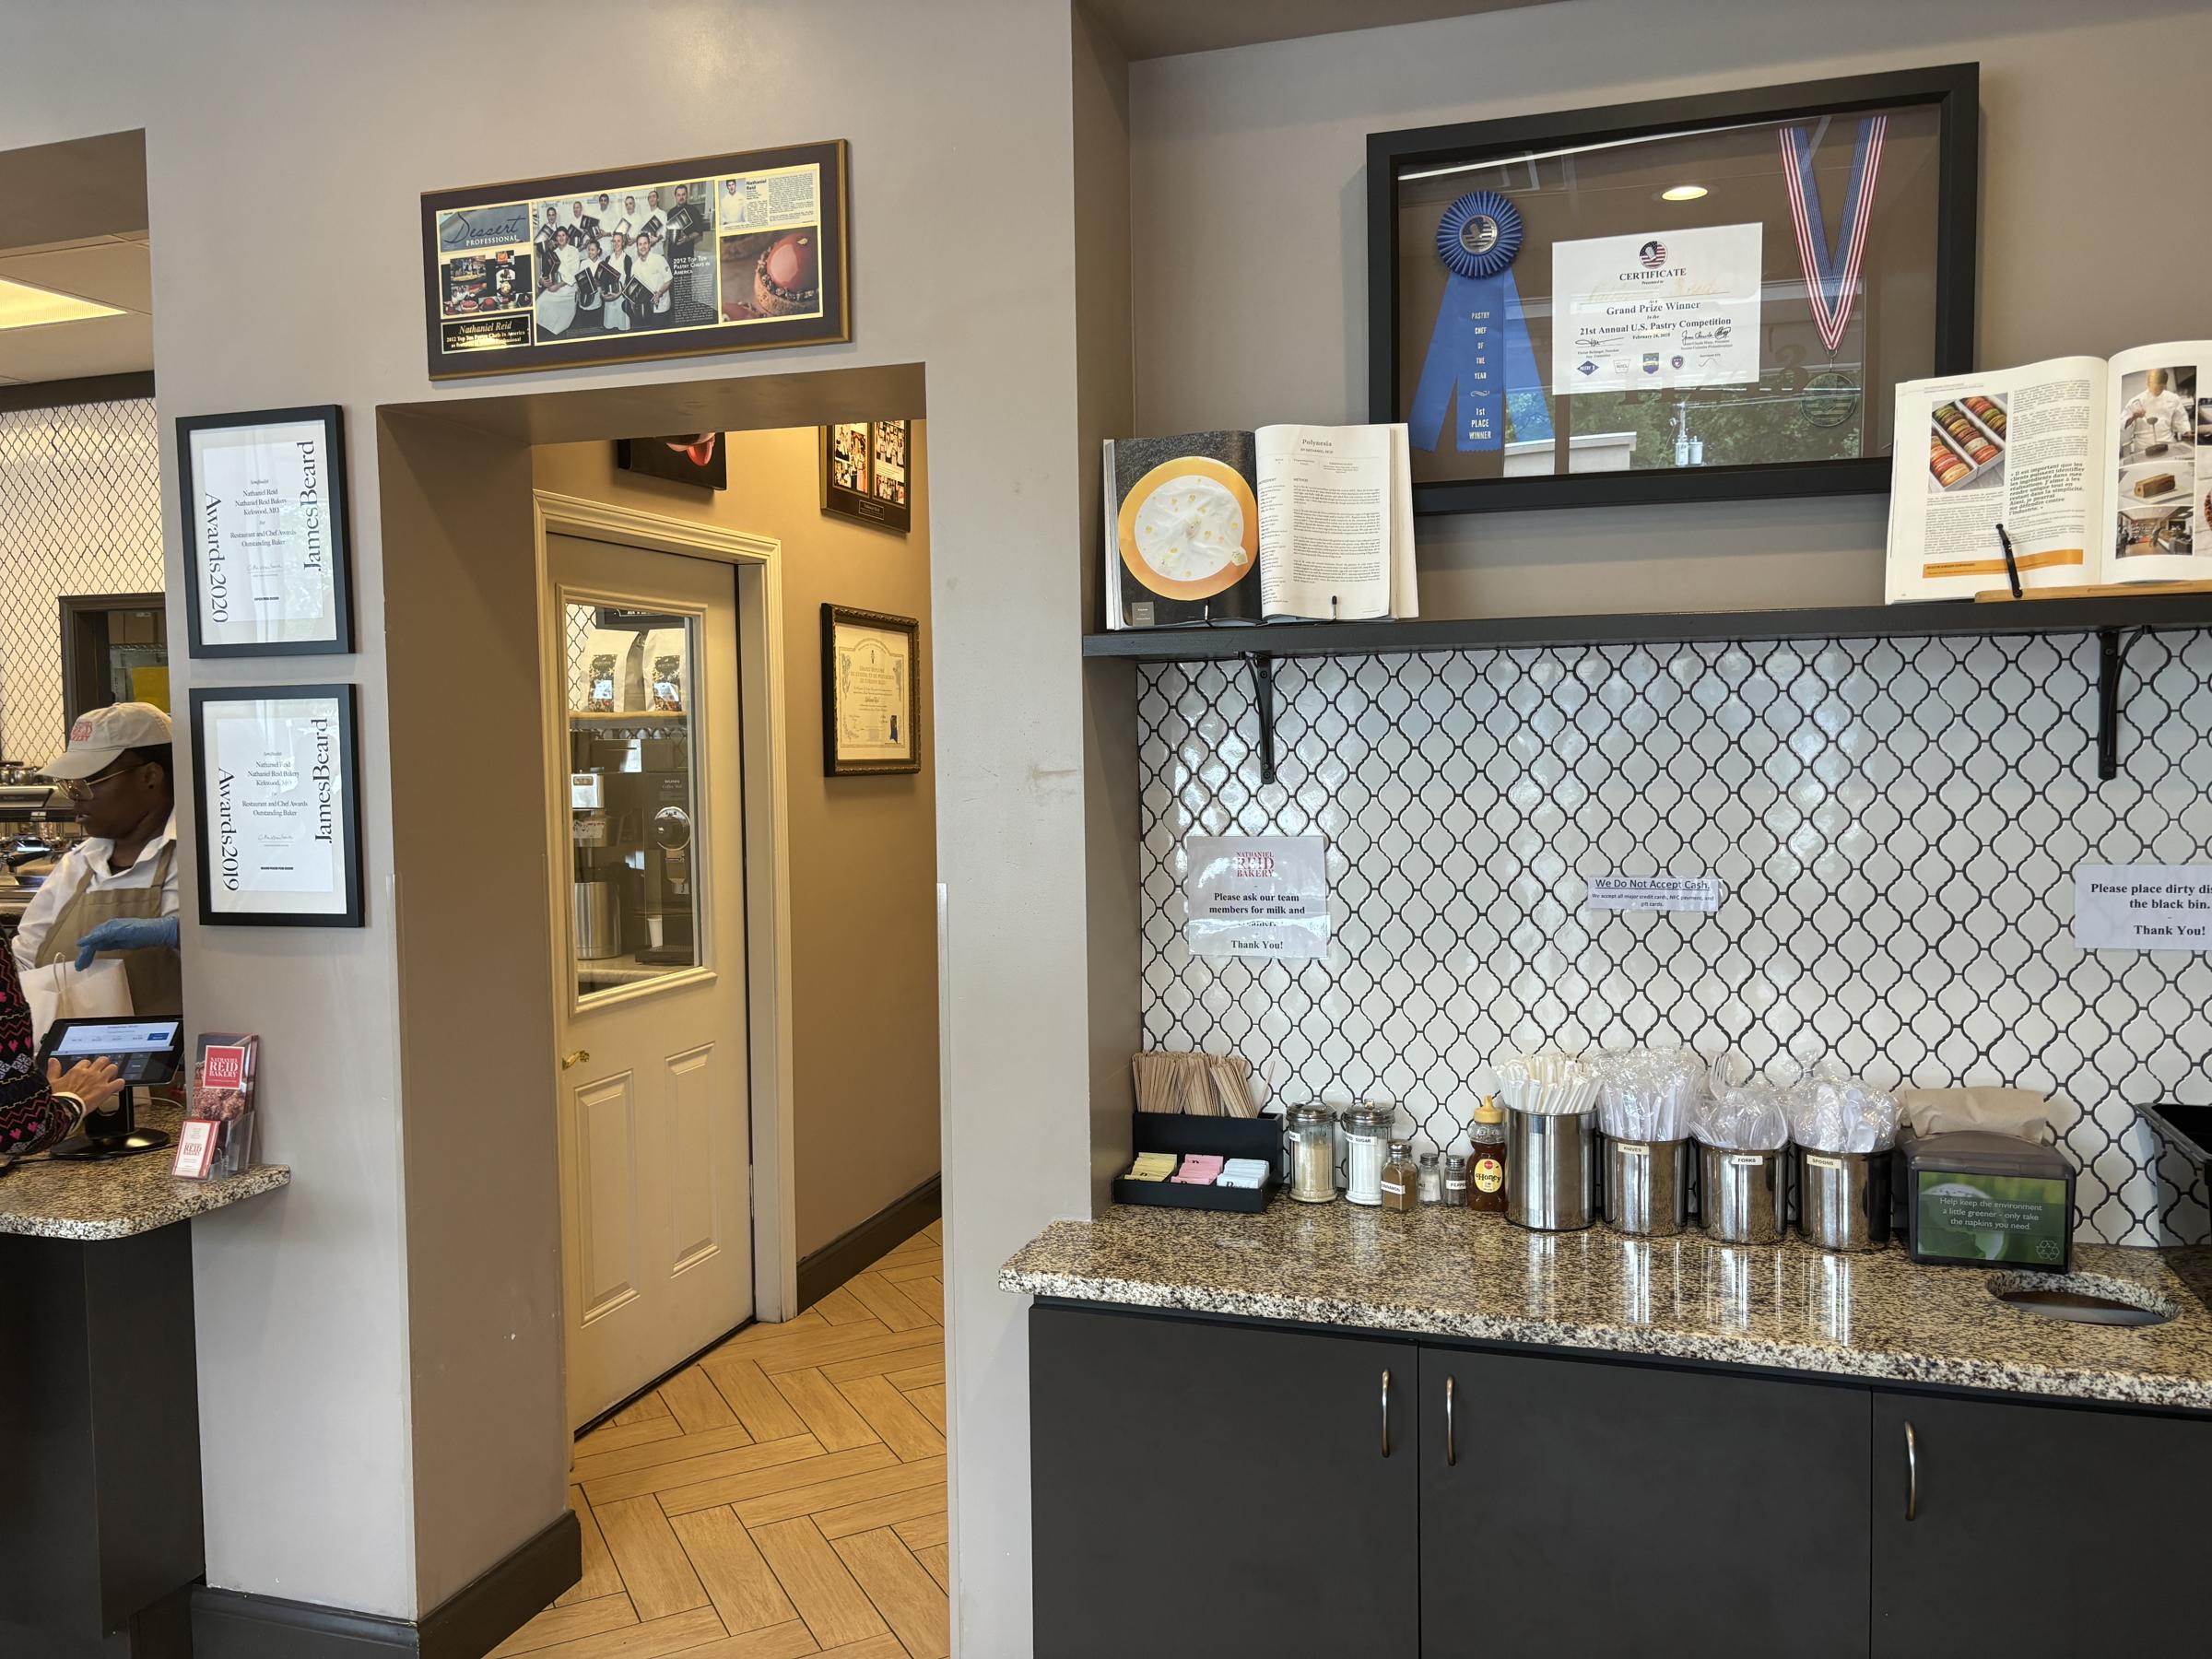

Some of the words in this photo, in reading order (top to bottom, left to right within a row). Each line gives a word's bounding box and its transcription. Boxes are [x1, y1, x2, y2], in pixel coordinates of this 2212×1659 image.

[443, 212, 526, 243] Dessert
[466, 234, 517, 247] PROFESSIONAL
[1619, 267, 1687, 281] CERTIFICATE
[1606, 305, 1636, 316] Grand
[1640, 302, 1663, 313] Prize
[1665, 301, 1700, 311] Winner
[1471, 312, 1490, 320] PASTRY
[459, 323, 493, 334] Nathaniel
[496, 321, 512, 331] Reid
[1474, 326, 1488, 335] CHEF
[1580, 327, 1596, 335] 21st
[1598, 324, 1629, 335] Annual
[1630, 323, 1648, 332] U.S.
[1650, 322, 1677, 332] Pastry
[1679, 318, 1731, 329] Competition
[1477, 342, 1484, 350] OF
[1476, 357, 1486, 365] THE
[1474, 371, 1487, 380] YEAR
[1476, 407, 1486, 416] 1st
[1471, 418, 1489, 428] PLACE
[1469, 430, 1491, 441] WINNER
[1302, 439, 1332, 447] Polynesia
[253, 809, 282, 818] Outstanding
[1237, 857, 1275, 870] REID
[1237, 869, 1275, 877] BAKERY
[1595, 879, 1611, 888] We
[1614, 879, 1627, 888] Do
[1630, 879, 1647, 888] Not
[1650, 880, 1682, 889] Accept
[1684, 880, 1711, 889] Cash.
[2090, 883, 2127, 893] Please
[2131, 884, 2162, 896] place
[2165, 884, 2194, 896] dirty
[1214, 892, 1241, 901] Please
[1242, 893, 1257, 901] ask
[2130, 899, 2148, 909] the
[2151, 899, 2184, 909] black
[2188, 900, 2210, 909] bin.
[1209, 905, 1249, 914] members
[1251, 905, 1264, 914] for
[1266, 905, 1287, 914] milk
[1288, 906, 1305, 914] and
[2134, 924, 2173, 935] Thank
[2177, 925, 2206, 935] You!
[1231, 940, 1260, 949] Thank
[1262, 940, 1283, 949] You!
[209, 1061, 239, 1072] REID
[1812, 1158, 1834, 1166] SPOONS
[1476, 1172, 1501, 1182] Honey
[1939, 1197, 1959, 1206] Help
[1959, 1198, 1978, 1207] keep
[1979, 1199, 1992, 1207] the
[1994, 1202, 2042, 1211] environment
[1948, 1207, 1966, 1216] little
[2004, 1212, 2021, 1221] only
[2022, 1213, 2040, 1221] take
[1950, 1218, 1963, 1226] the
[1964, 1219, 1993, 1229] napkins
